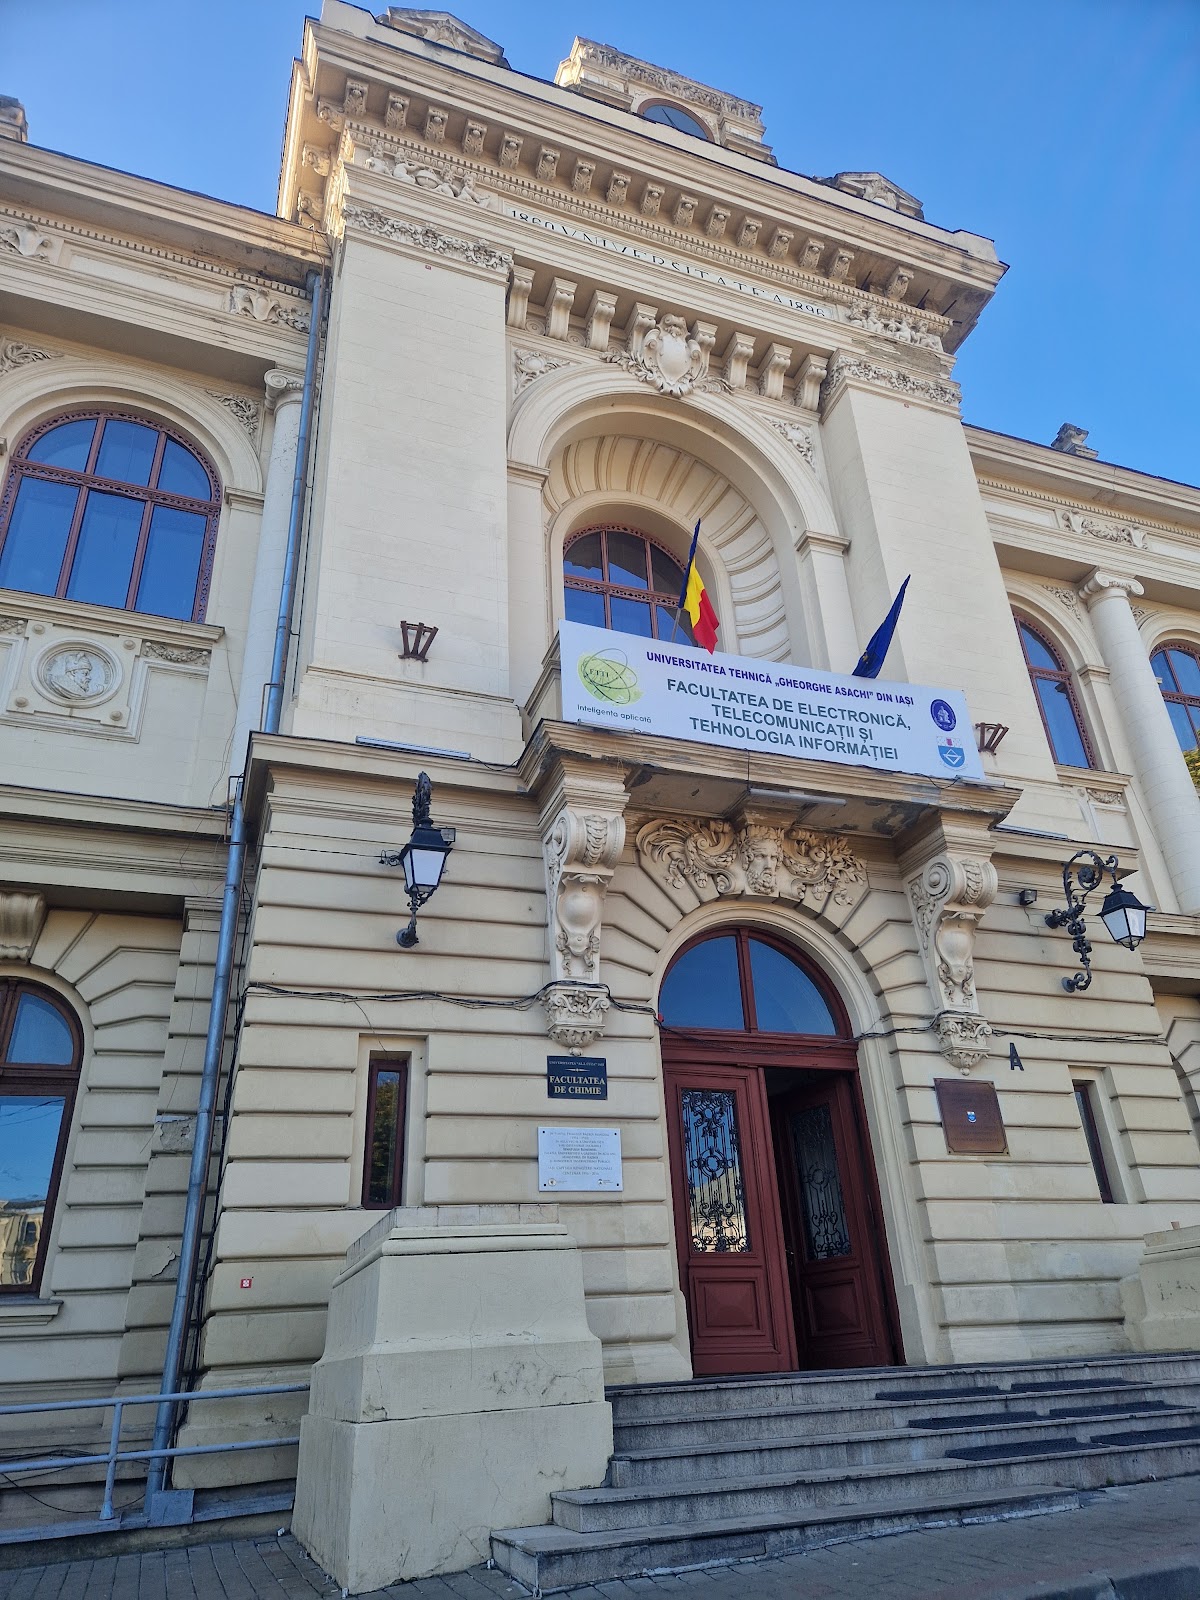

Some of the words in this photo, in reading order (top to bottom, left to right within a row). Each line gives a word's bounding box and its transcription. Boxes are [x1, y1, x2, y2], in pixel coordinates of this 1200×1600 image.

[589, 668, 610, 679] ETTI
[646, 651, 727, 676] UNIVERSITATEA
[728, 667, 772, 685] TEHNICĂ
[774, 676, 833, 694] „GHEORGHE
[834, 685, 874, 700] ASACHI”
[876, 692, 894, 704] DIN
[895, 695, 915, 707] IAȘI
[620, 712, 652, 724] aplicată
[666, 678, 769, 709] FACULTATEA
[772, 697, 793, 714] DE
[797, 702, 912, 731] ELECTRONICĂ,
[689, 716, 796, 748] TEHNOLOGIA
[798, 735, 899, 762] INFORMAȚIEI
[711, 703, 855, 742] TELECOMUNICAȚII
[858, 726, 874, 745] ȘI
[1009, 1042, 1025, 1072] A
[549, 1075, 606, 1085] FACULTATEA
[554, 1085, 567, 1094] DE
[568, 1086, 602, 1095] CHIMIE
